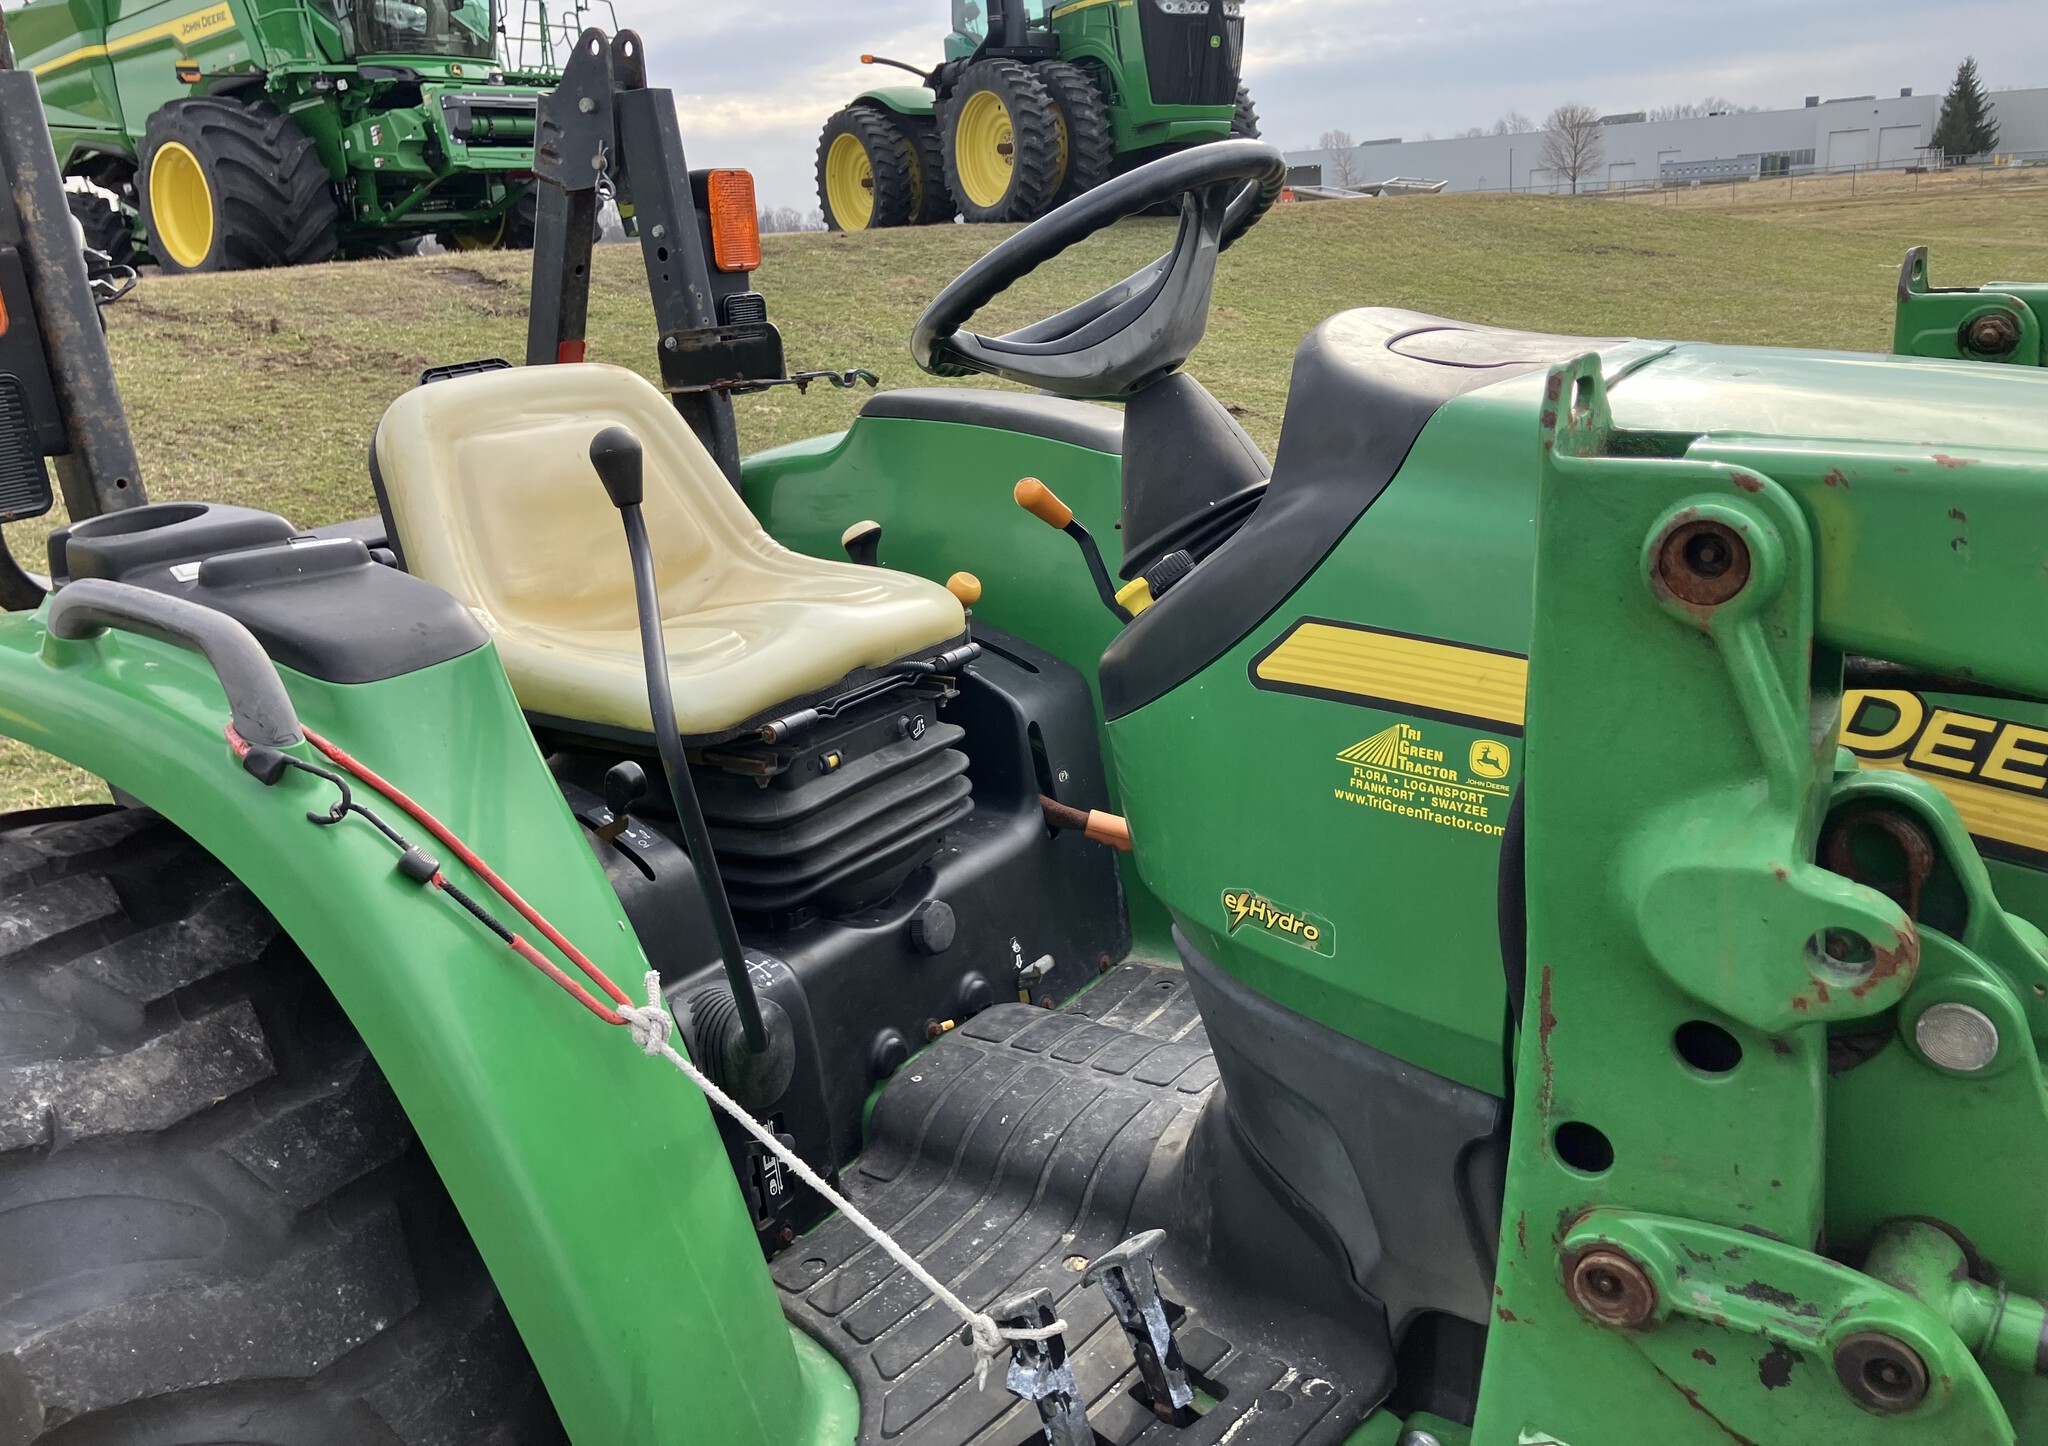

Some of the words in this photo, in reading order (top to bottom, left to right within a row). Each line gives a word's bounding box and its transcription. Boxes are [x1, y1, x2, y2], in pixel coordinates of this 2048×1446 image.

[182, 22, 200, 35] JOHN
[201, 11, 226, 27] DEERE
[1400, 723, 1421, 741] TRI
[1399, 740, 1444, 762] GREEN
[1398, 755, 1458, 782] TRACTOR
[1353, 766, 1388, 784] FLORA
[1403, 778, 1485, 804] LOGANSPORT
[1465, 777, 1485, 787] JOHN
[1486, 781, 1510, 792] DEERE
[1349, 777, 1415, 802] FRANKFORT
[1431, 797, 1488, 818] SWAYZEE
